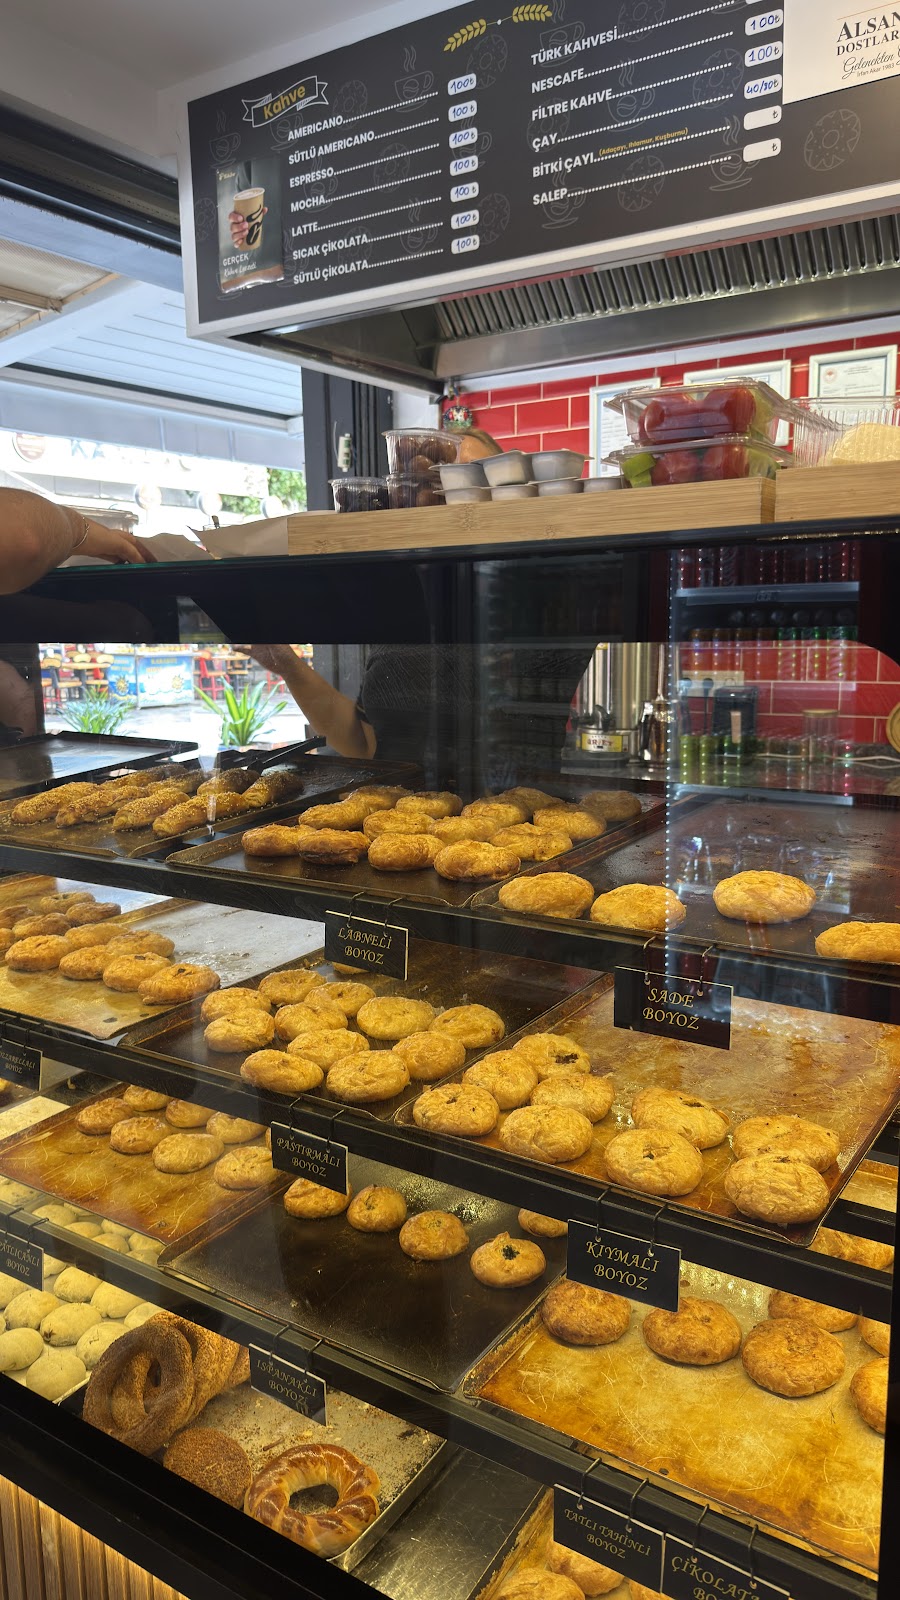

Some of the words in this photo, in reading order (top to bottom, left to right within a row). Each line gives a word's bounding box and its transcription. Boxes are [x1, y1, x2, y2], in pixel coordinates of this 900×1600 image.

[531, 46, 562, 65] TÜRK
[564, 26, 618, 54] KAHVESİ
[836, 30, 900, 56] DOSTLAR
[532, 68, 584, 93] NESCAFE
[263, 85, 306, 120] Kahve
[532, 101, 568, 121] FİLTRE
[570, 89, 612, 111] KAHVE
[288, 116, 343, 141] AMERICANO
[289, 147, 316, 164] SÜTLÜ
[318, 131, 374, 156] AMERICANO
[532, 133, 558, 152] ÇAY
[533, 157, 562, 177] BİTKİ
[564, 152, 593, 173] ÇAYI
[290, 167, 334, 188] ESPRESSO
[291, 195, 326, 212] MOCHA
[533, 188, 567, 205] SALEP
[292, 222, 318, 237] LATTE
[293, 245, 320, 260] SICAK
[322, 234, 368, 256] ÇİKOLATA
[294, 269, 321, 285] SÜTLÜ
[323, 260, 369, 281] ÇİKOLATA
[338, 928, 392, 949] LABNELİ
[344, 946, 384, 964] BOYOZ
[648, 988, 694, 1008] SADE
[642, 1007, 699, 1030] BOYOZ
[277, 1138, 340, 1168] PASTIRMALI
[292, 1157, 326, 1177] BOYOZ
[6, 1259, 30, 1276] BOYOZ
[586, 1241, 659, 1272] KIYMALI
[594, 1264, 648, 1290] BOYOZ
[257, 1360, 316, 1397] ISPANAKLI
[269, 1380, 304, 1405] BOYOZ
[564, 1509, 597, 1531] TATLI
[599, 1525, 651, 1556] TAHİNLİ
[587, 1534, 625, 1559] BOYOZ
